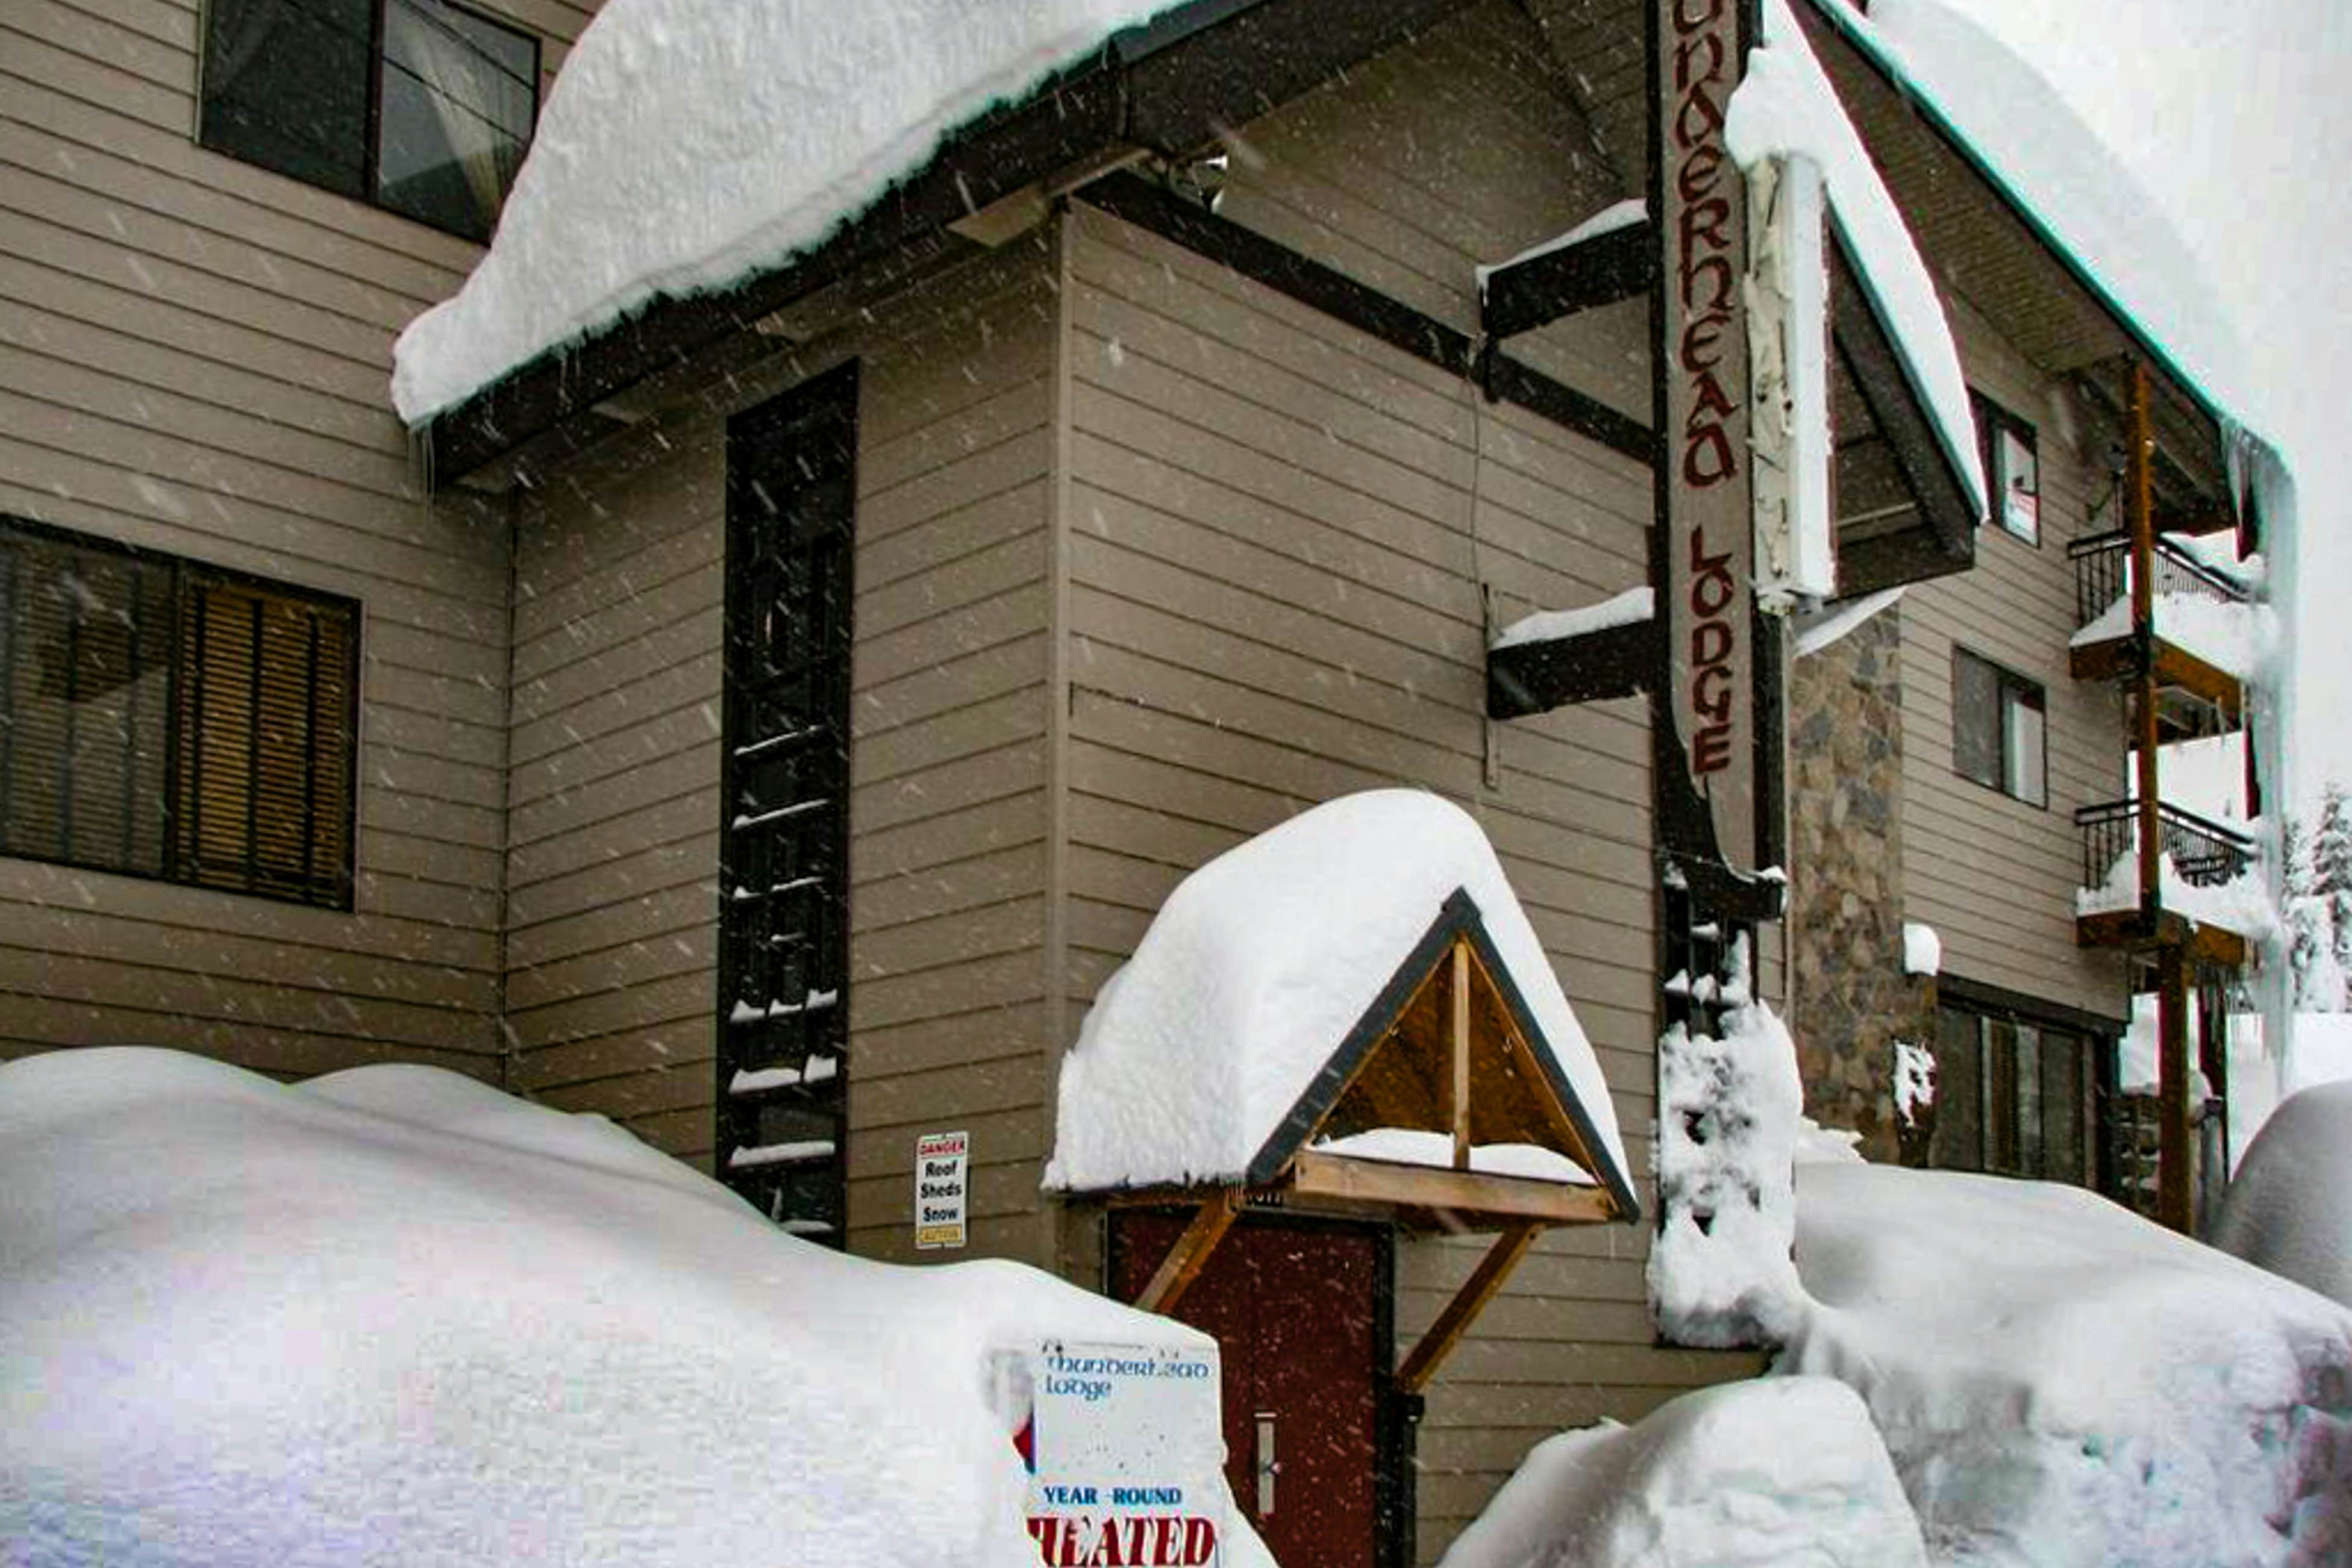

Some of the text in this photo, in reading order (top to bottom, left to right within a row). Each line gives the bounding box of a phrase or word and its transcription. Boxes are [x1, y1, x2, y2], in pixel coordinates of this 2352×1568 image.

[1690, 525, 1734, 774] LODGE
[925, 1160, 958, 1178] Roof
[921, 1183, 963, 1199] Sheds
[923, 1207, 959, 1222] Snow
